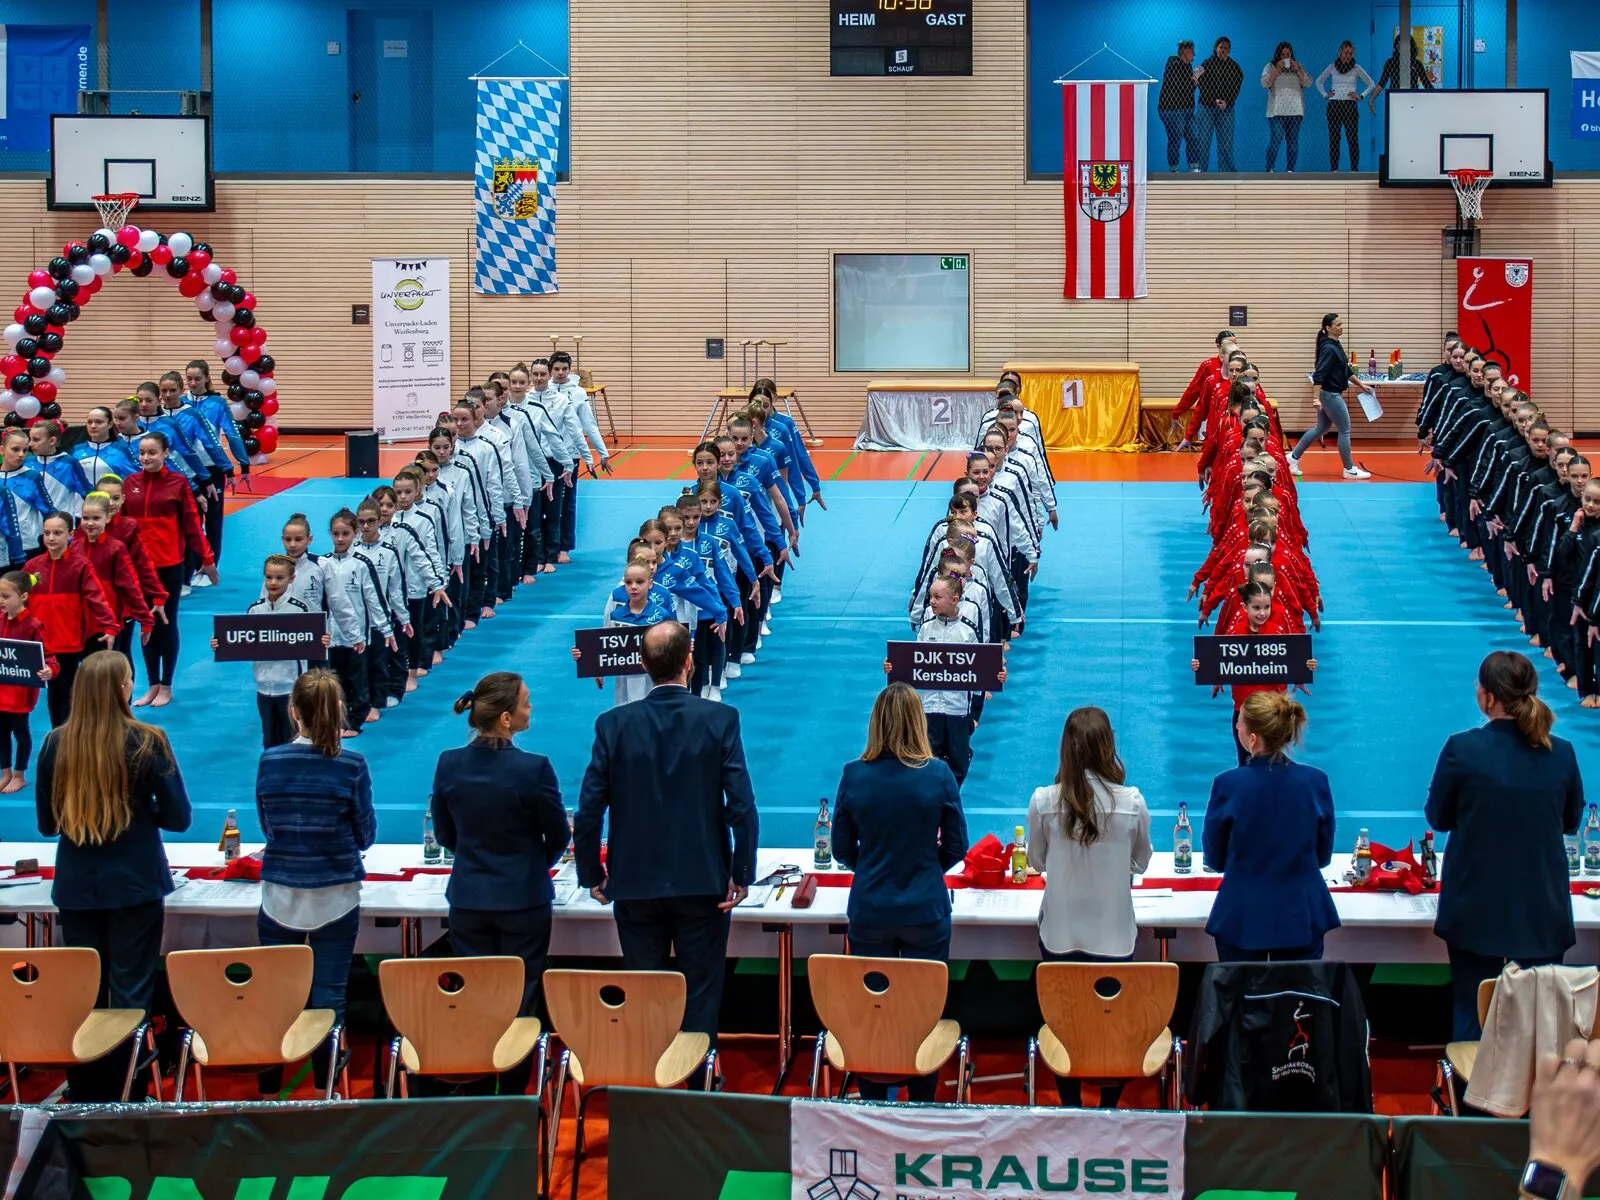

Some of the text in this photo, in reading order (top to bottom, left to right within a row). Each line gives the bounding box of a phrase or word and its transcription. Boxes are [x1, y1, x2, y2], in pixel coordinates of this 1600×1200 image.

[838, 13, 876, 26] HEIM
[925, 13, 966, 26] GAST
[77, 46, 88, 91] rnen.de
[888, 65, 915, 73] SCHAUF
[380, 289, 442, 299] UNVERPACKT
[1066, 382, 1078, 406] 1
[933, 398, 950, 423] 2
[226, 629, 314, 645] UFC Ellingen
[599, 634, 643, 649] TSV 1
[0, 647, 17, 660] JK
[1219, 643, 1287, 657] TSV 1895
[914, 651, 976, 665] DJK TSV
[1219, 661, 1288, 675] Monheim
[912, 668, 977, 683] Kersbach
[894, 1152, 1169, 1194] KRAUSE
